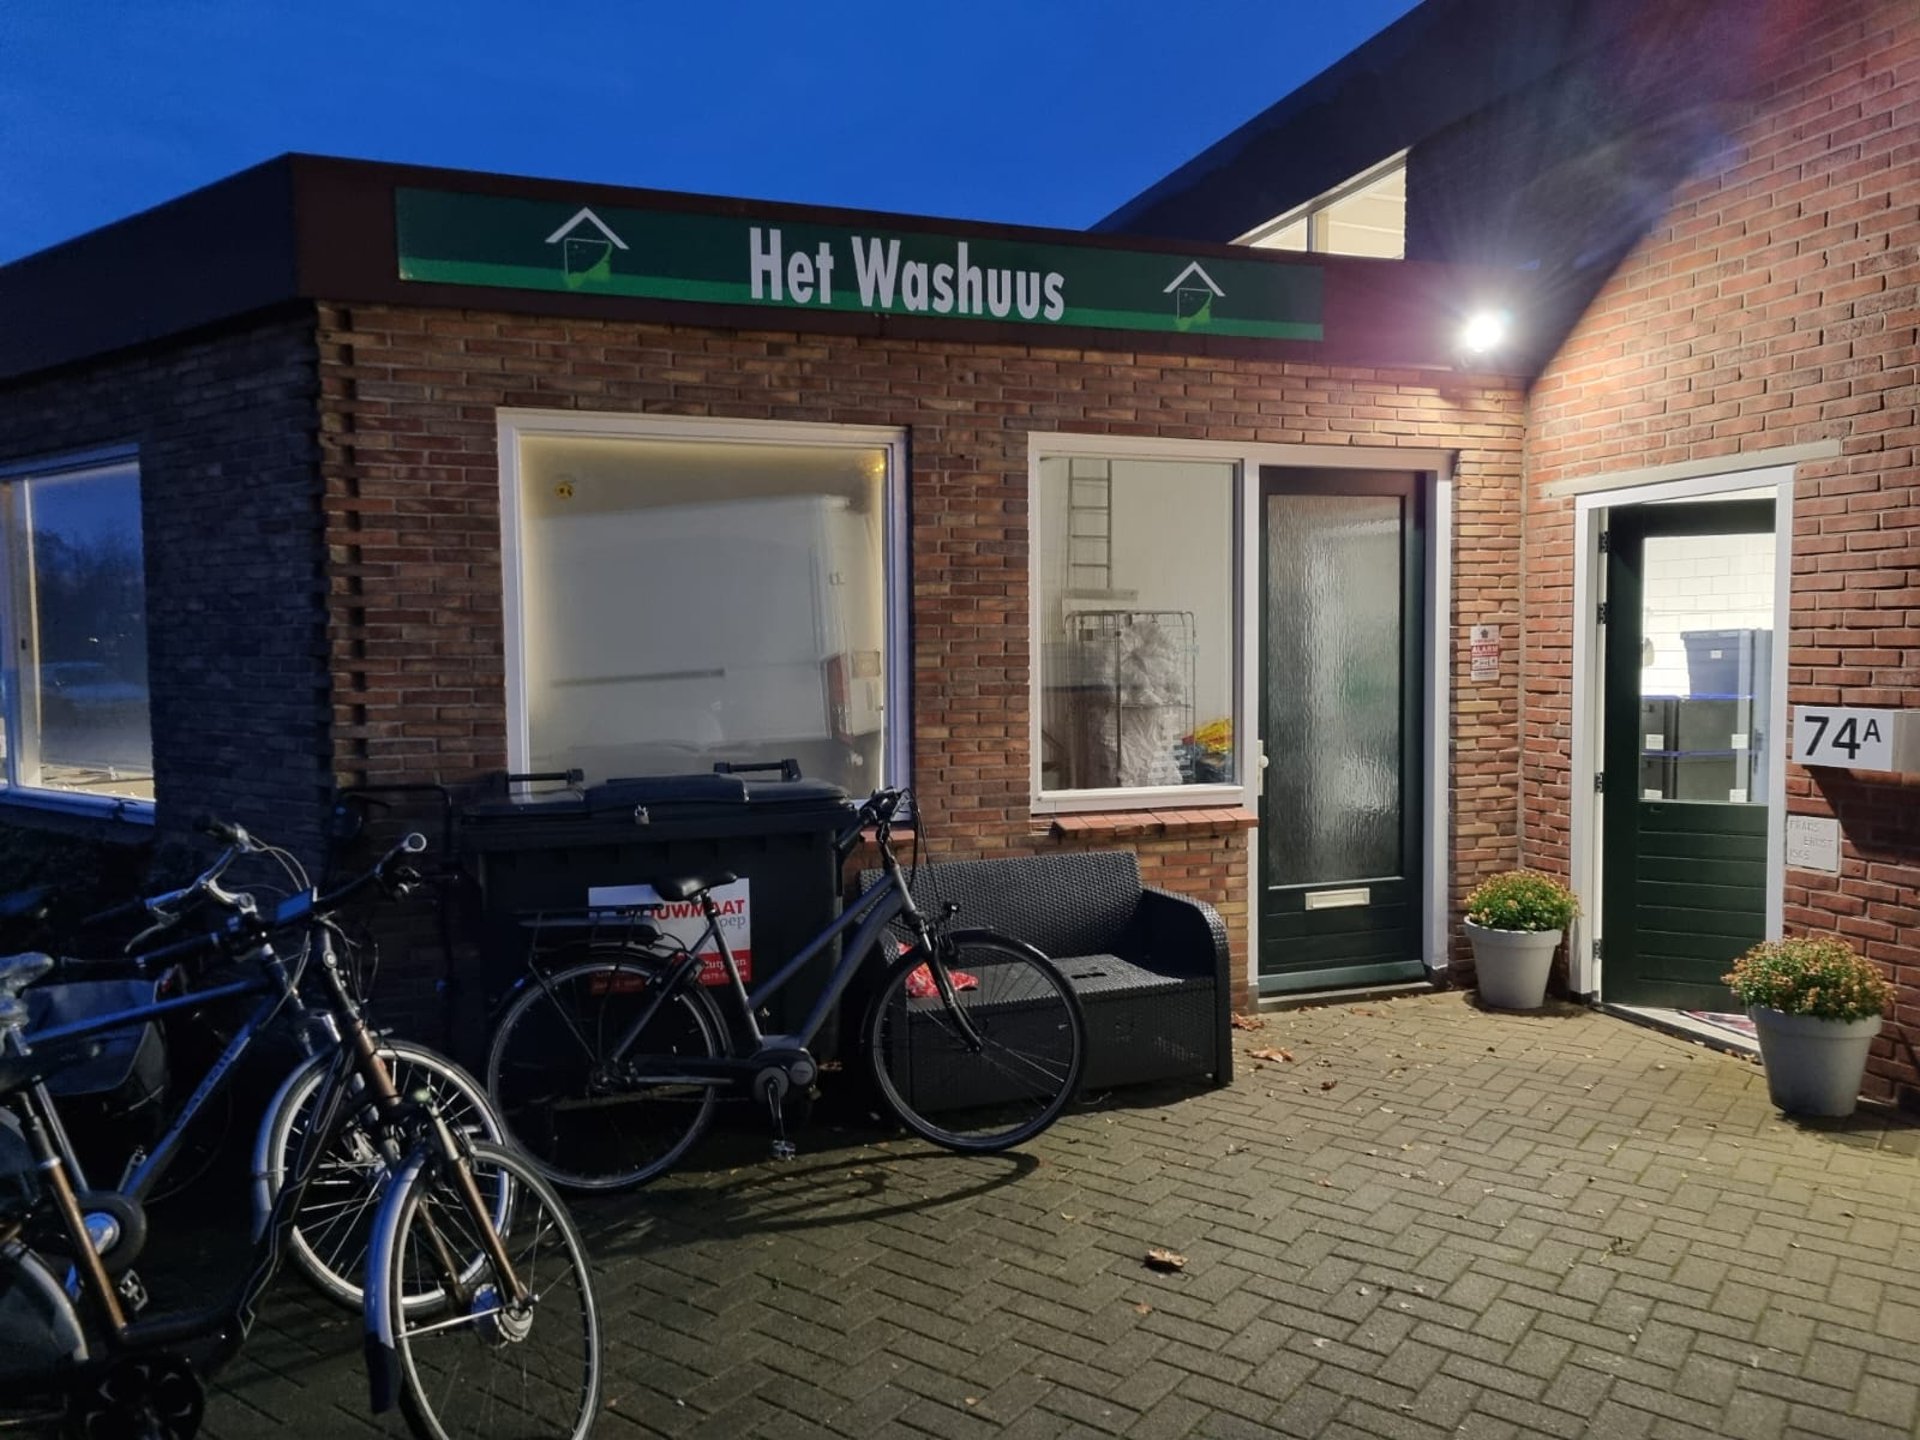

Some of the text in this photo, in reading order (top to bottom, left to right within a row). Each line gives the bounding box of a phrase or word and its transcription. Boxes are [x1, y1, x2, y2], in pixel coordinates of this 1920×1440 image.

[750, 227, 1065, 321] Het Washuus
[1804, 715, 1882, 760] 74A
